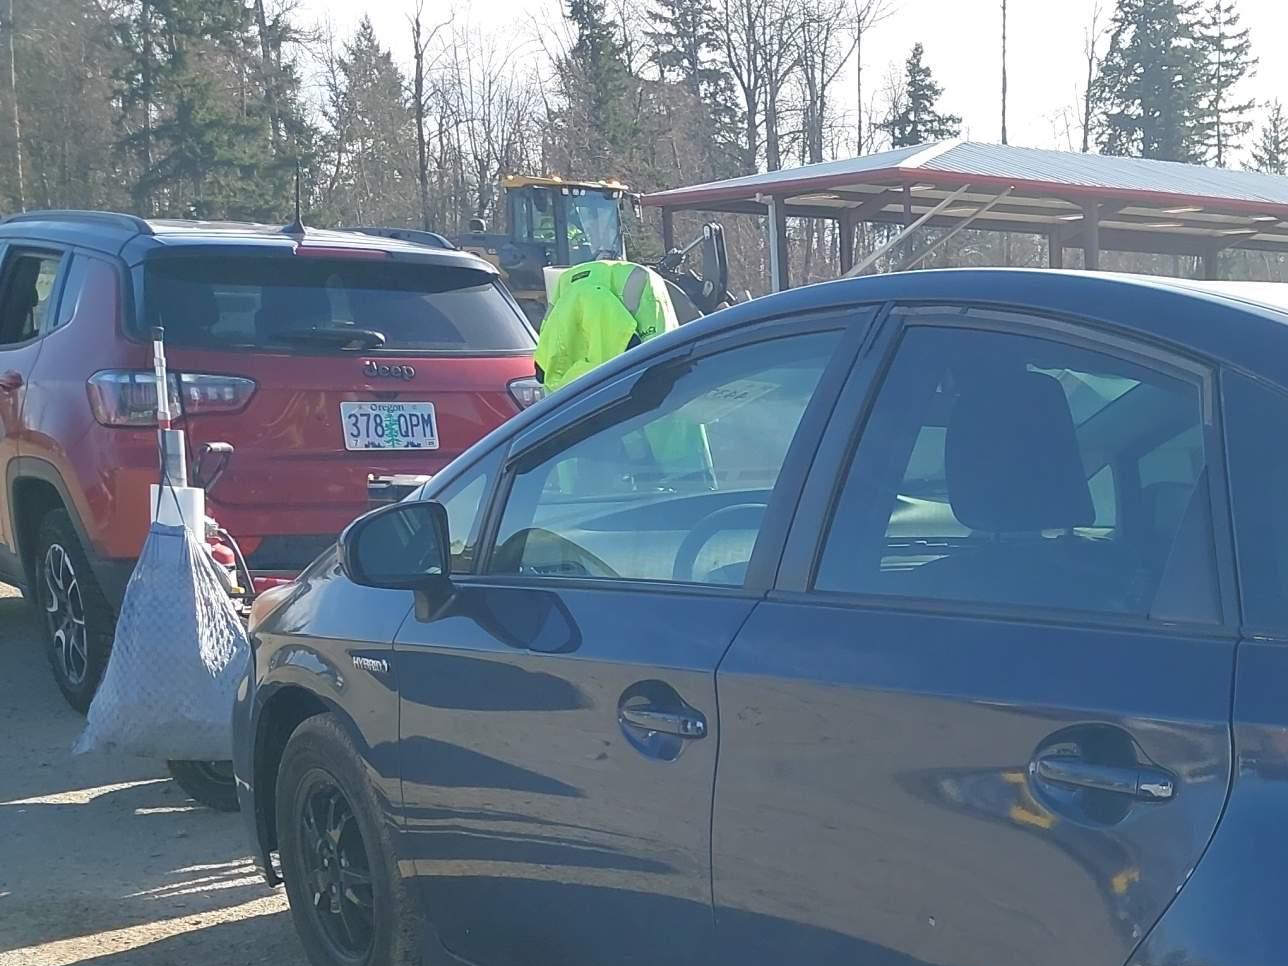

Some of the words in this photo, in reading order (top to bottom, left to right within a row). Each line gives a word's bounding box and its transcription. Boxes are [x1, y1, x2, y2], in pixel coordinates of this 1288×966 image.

[363, 360, 415, 381] Jeep
[370, 403, 405, 413] Oregon
[348, 413, 385, 438] 378
[397, 413, 434, 438] QPM
[352, 656, 383, 672] HYBRID
